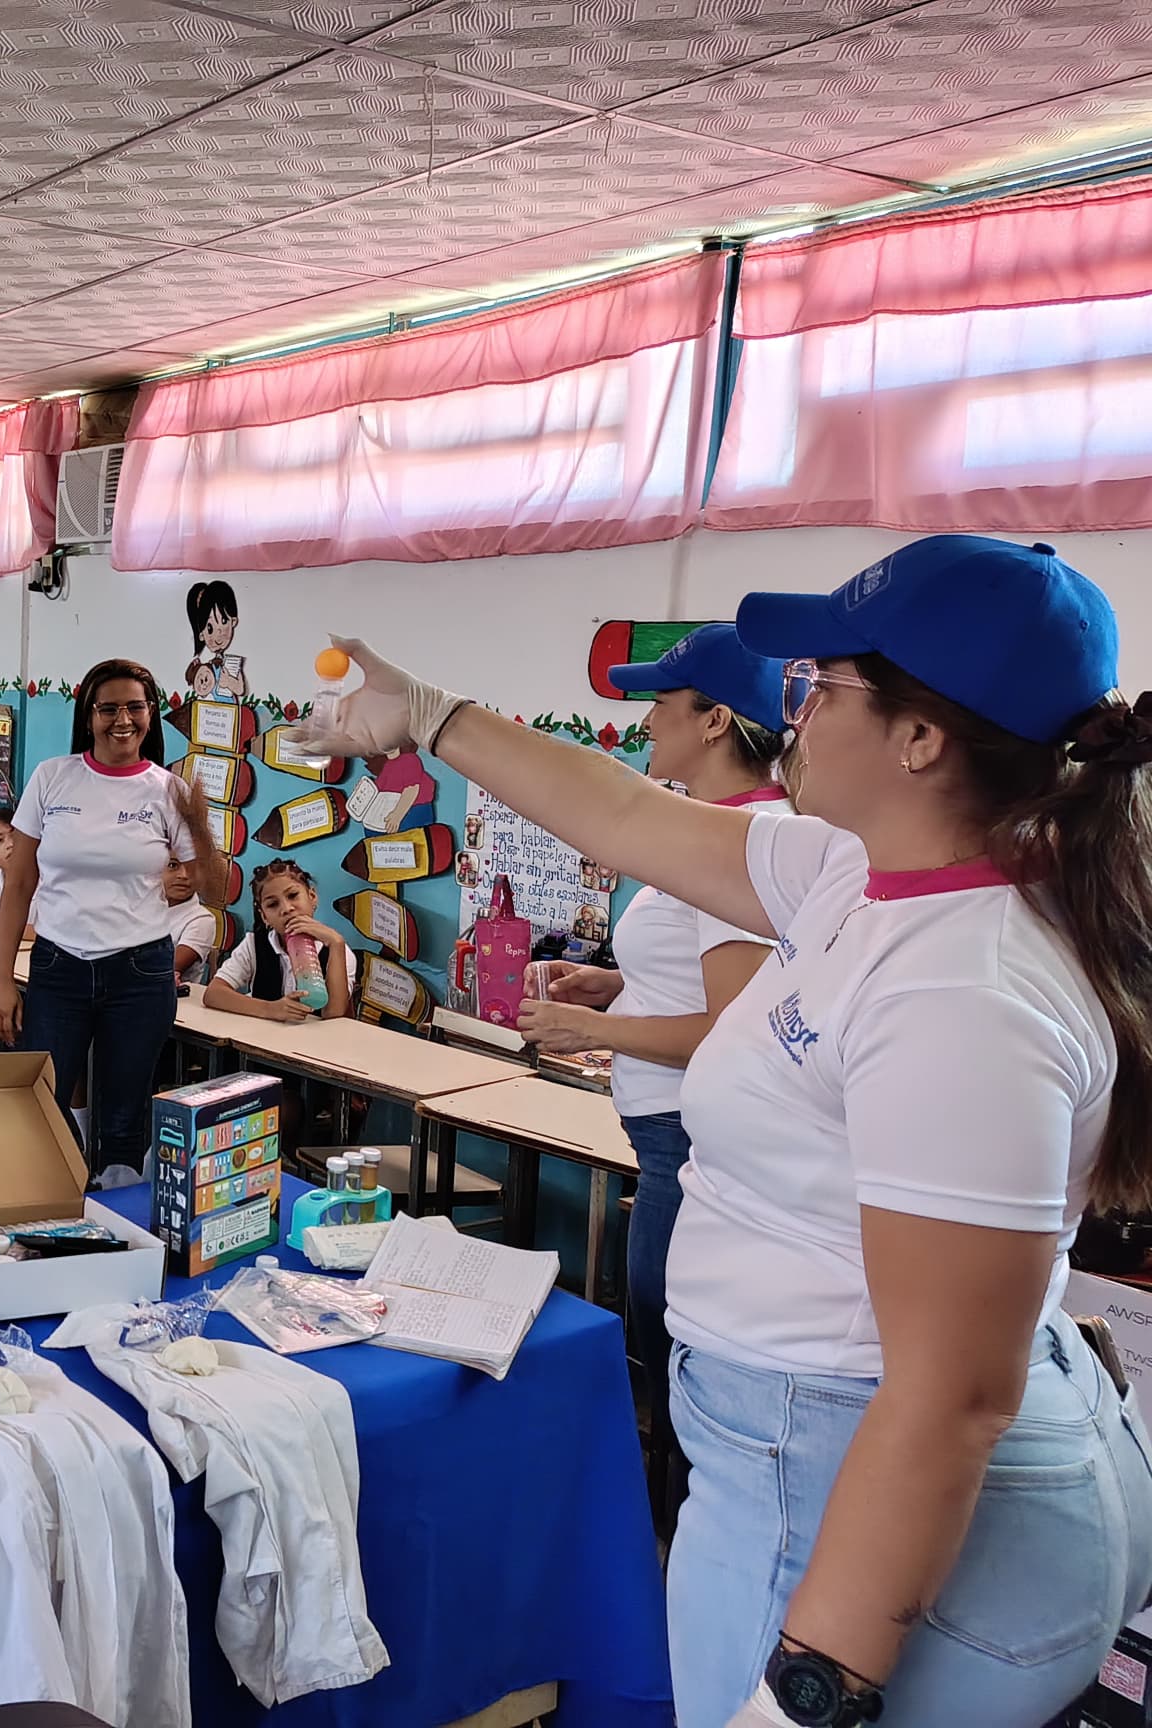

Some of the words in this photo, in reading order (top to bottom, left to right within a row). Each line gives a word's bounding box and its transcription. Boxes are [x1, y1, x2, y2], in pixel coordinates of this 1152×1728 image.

[493, 831, 513, 845] para
[491, 853, 524, 875] Hablar
[527, 865, 541, 878] sin
[511, 875, 524, 894] los
